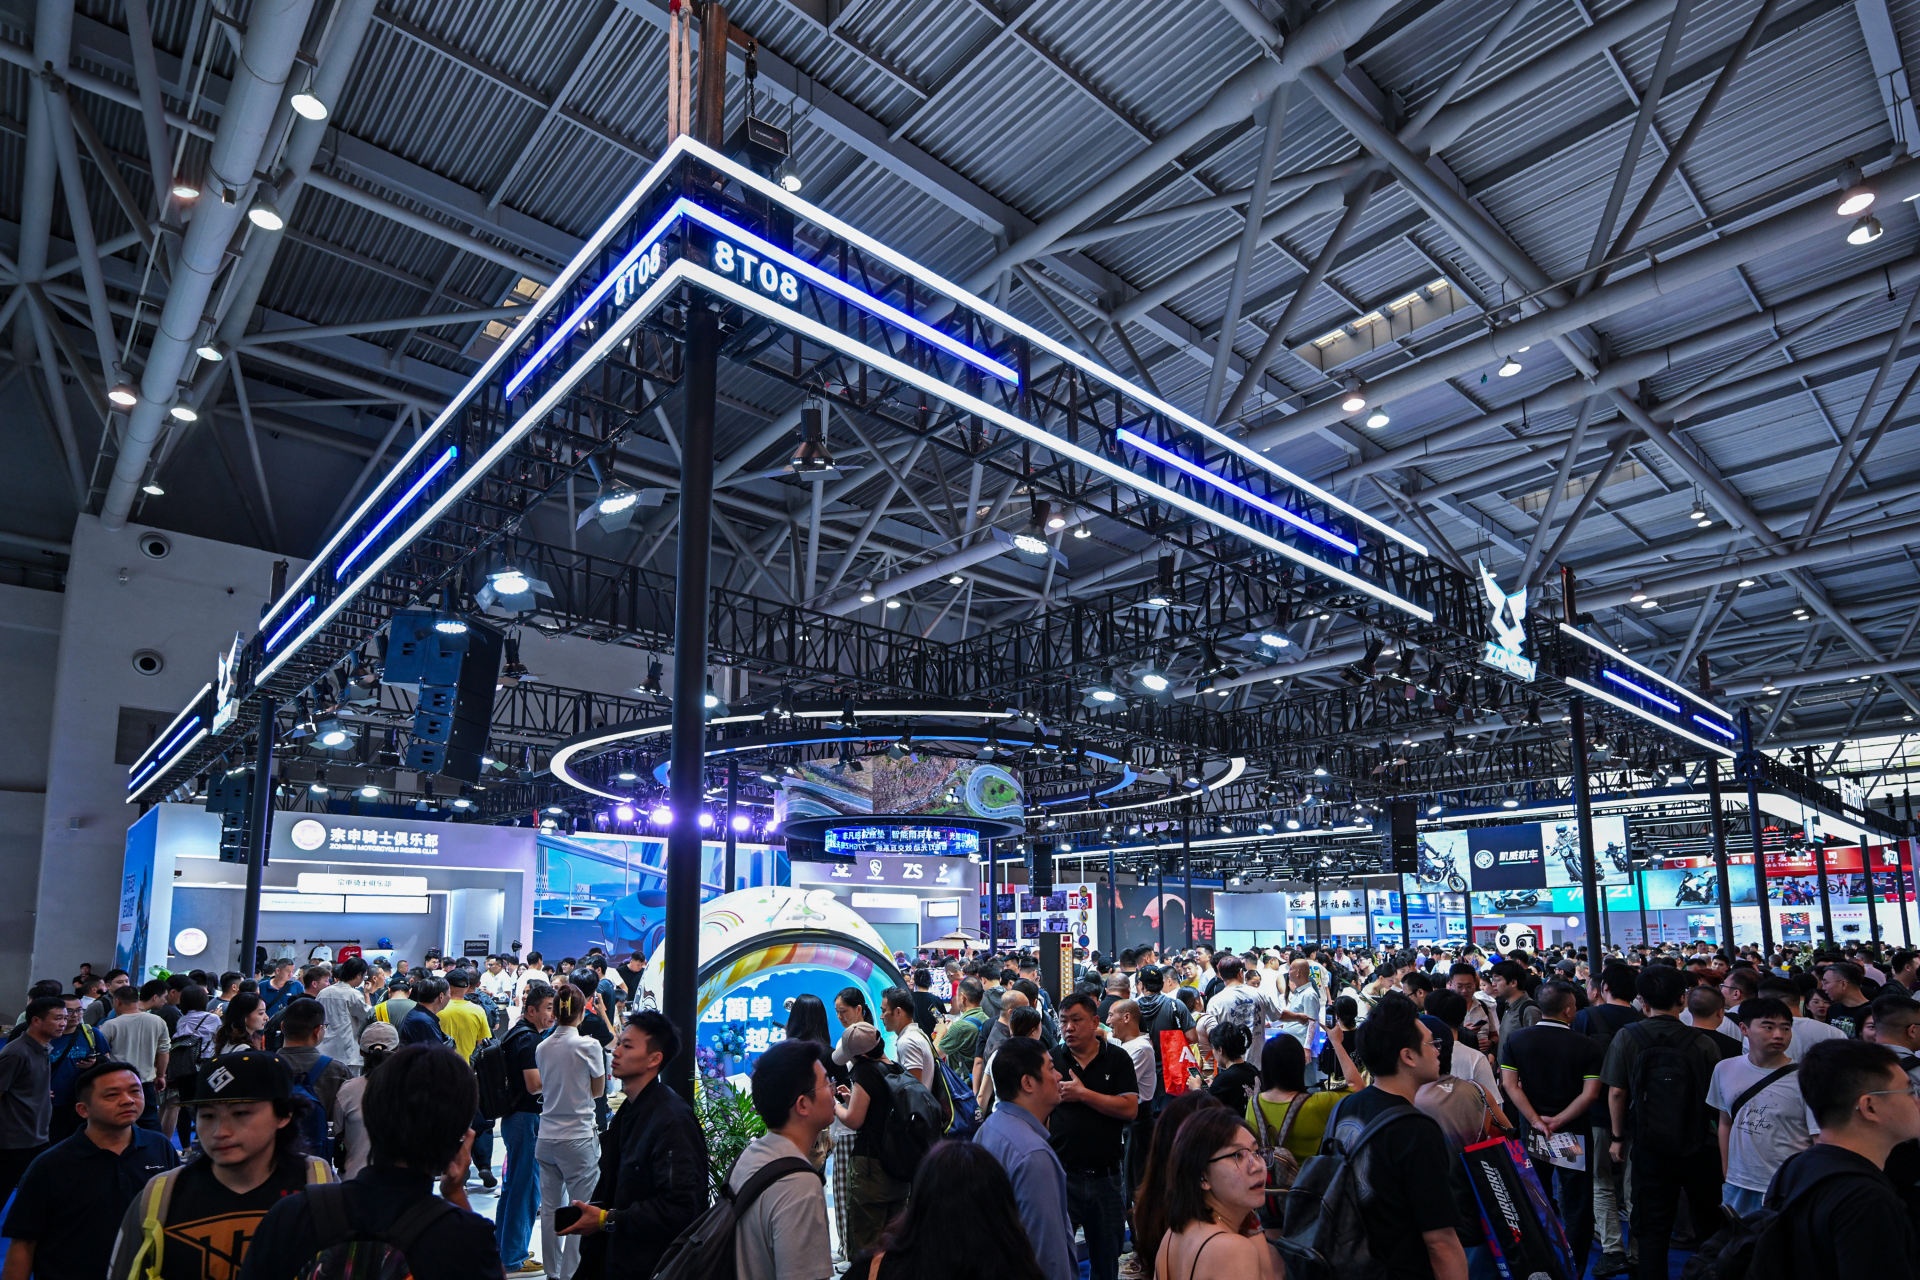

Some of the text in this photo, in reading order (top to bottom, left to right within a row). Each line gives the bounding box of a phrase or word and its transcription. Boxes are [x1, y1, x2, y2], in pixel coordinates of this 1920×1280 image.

[615, 242, 661, 306] 8T08
[714, 240, 799, 302] 8T08
[903, 862, 924, 880] ZS
[1290, 899, 1306, 908] KSF
[1480, 1160, 1520, 1232] EUROGRIP
